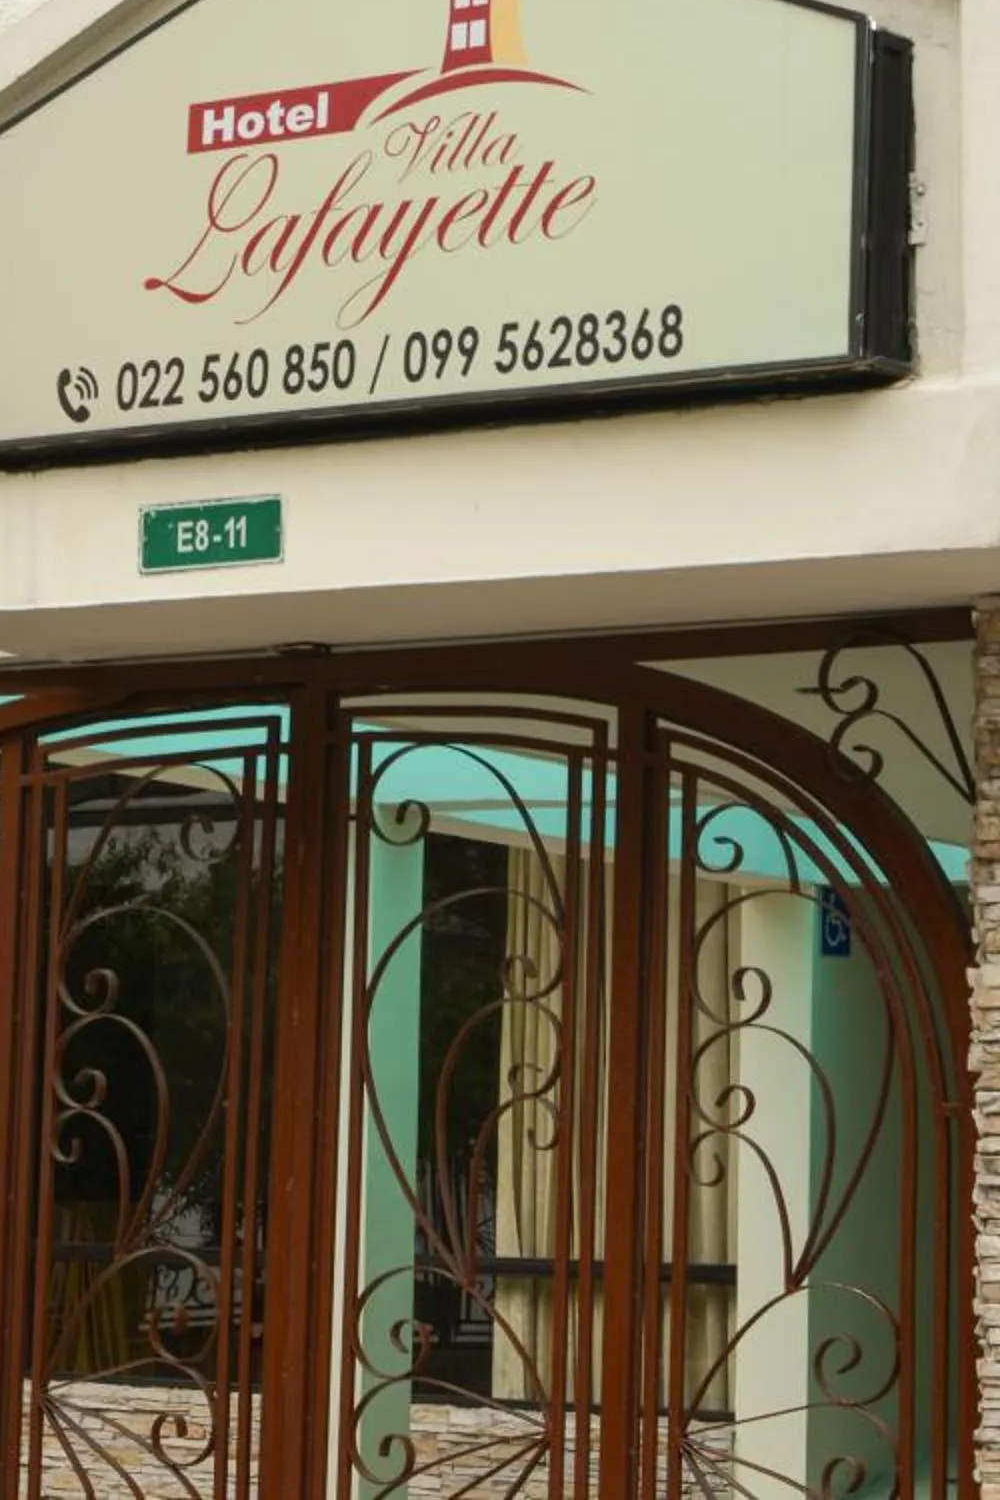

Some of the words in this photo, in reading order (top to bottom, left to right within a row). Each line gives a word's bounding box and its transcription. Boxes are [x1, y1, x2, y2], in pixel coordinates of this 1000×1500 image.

[200, 92, 330, 145] Hotel
[384, 110, 518, 184] Villa
[143, 152, 598, 331] Lafayette
[116, 357, 185, 412] 022
[199, 348, 269, 402] 560
[282, 338, 356, 394] 850
[369, 335, 390, 395] /
[402, 326, 479, 383] 099
[493, 304, 684, 374] 5628368
[176, 515, 248, 553] E8-11
